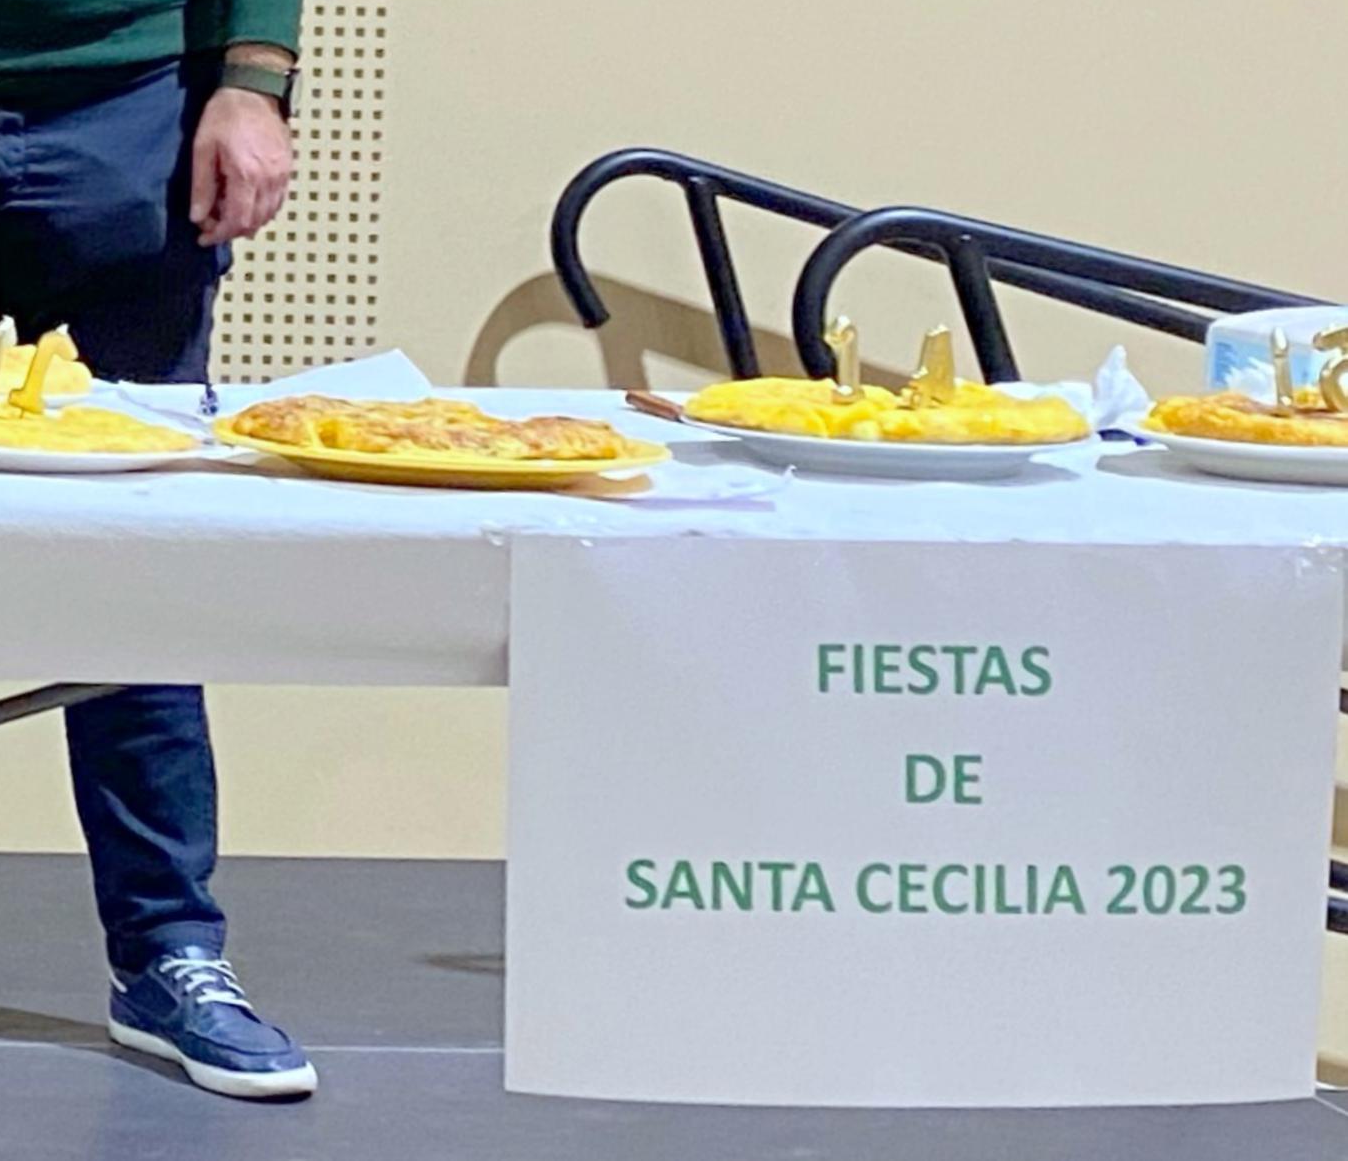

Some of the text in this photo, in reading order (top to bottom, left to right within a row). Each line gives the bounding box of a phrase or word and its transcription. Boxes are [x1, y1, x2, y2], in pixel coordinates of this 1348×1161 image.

[817, 643, 1054, 699] FIESTAS
[905, 753, 984, 806] DE
[624, 858, 1249, 916] SANTA CECILIA 2023
